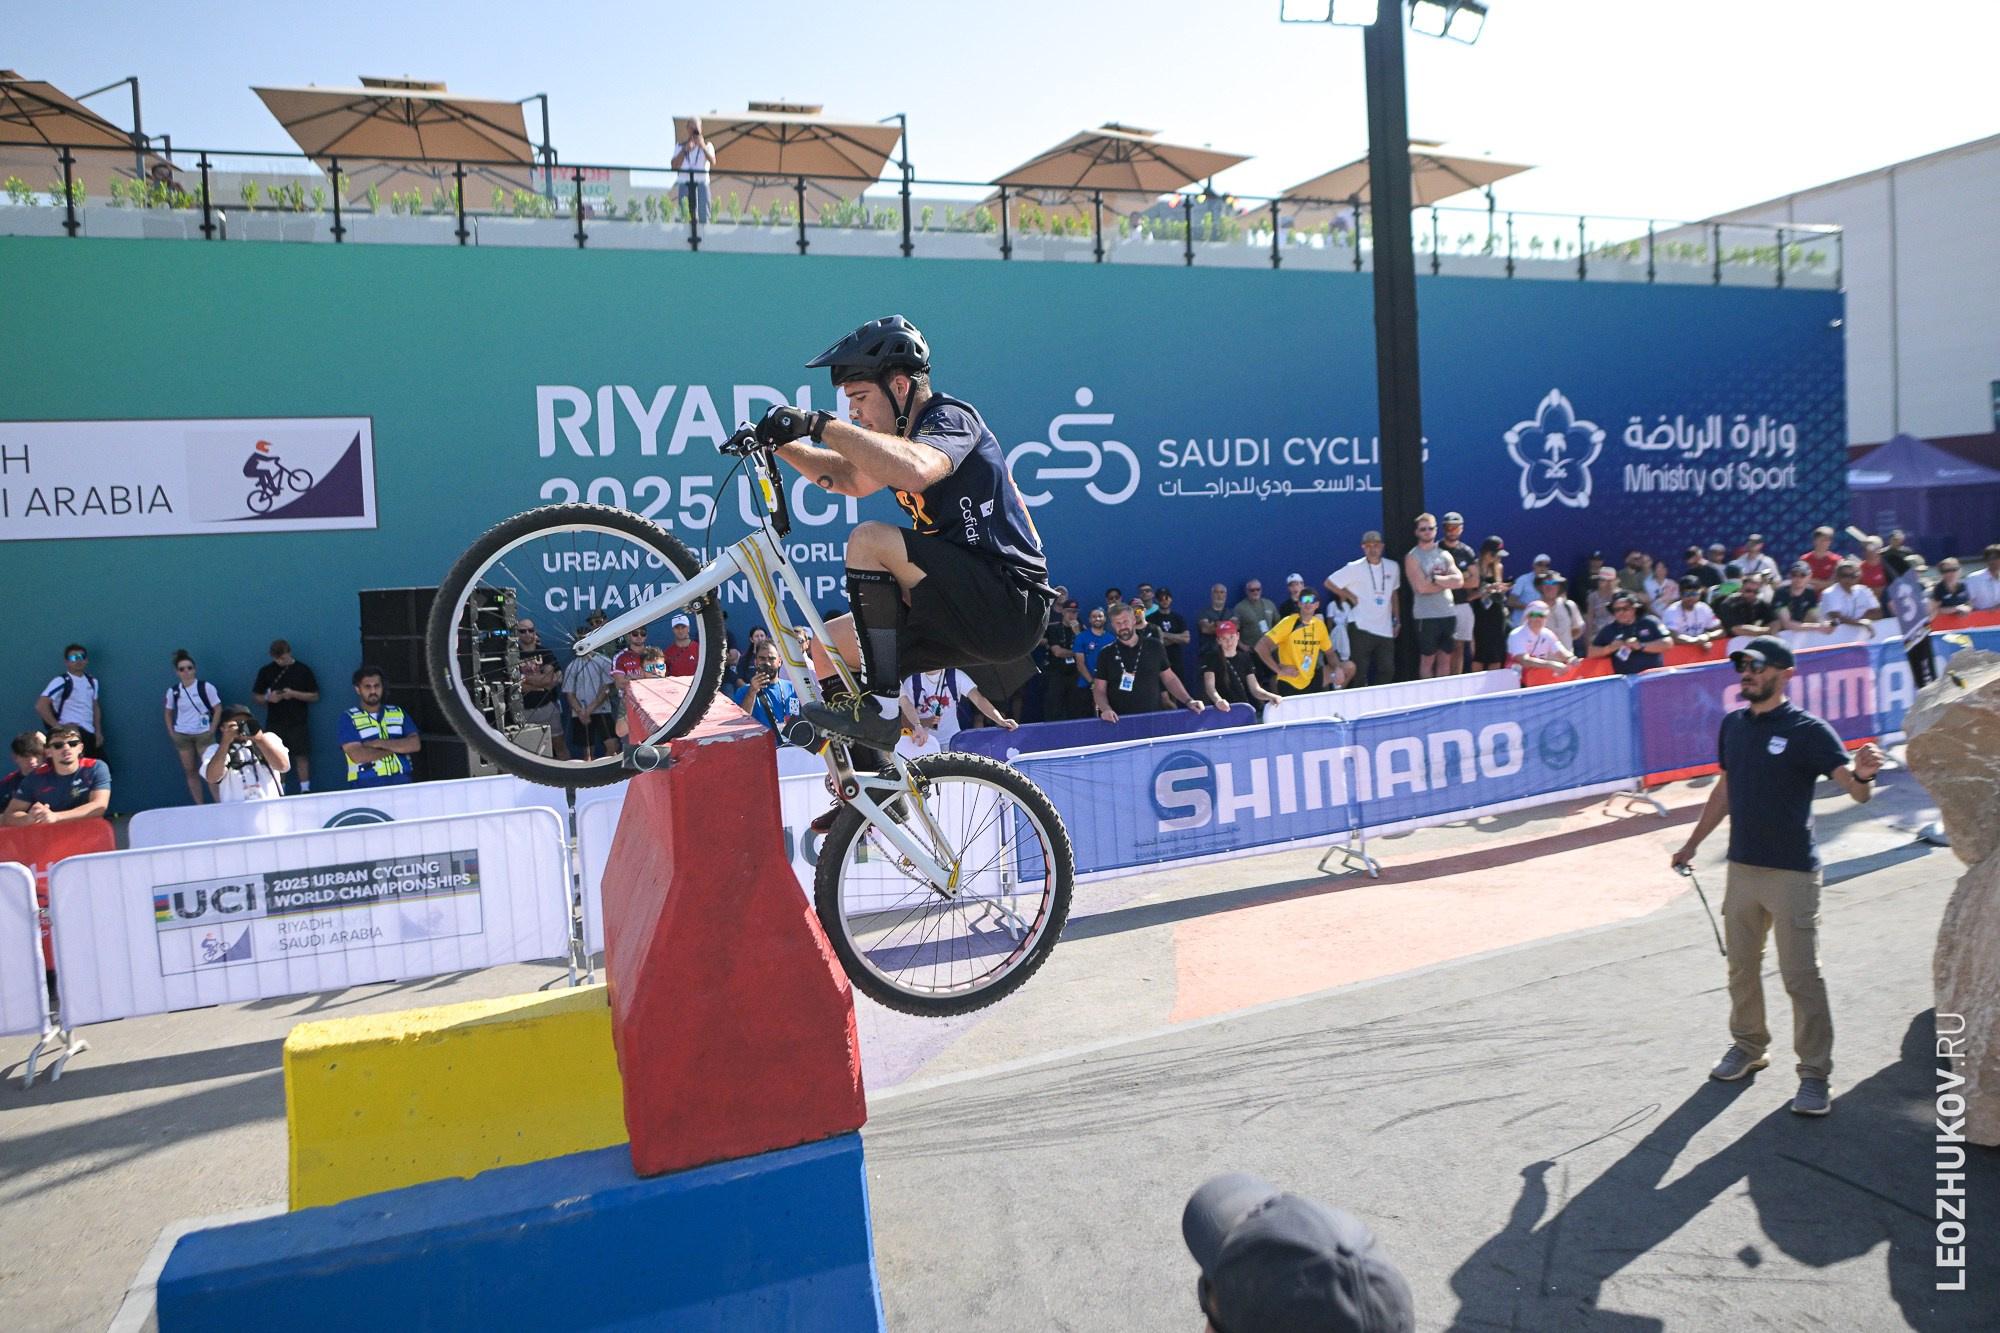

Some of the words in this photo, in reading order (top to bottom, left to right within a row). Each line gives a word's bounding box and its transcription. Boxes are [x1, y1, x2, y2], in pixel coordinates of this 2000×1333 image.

[1158, 437, 1270, 468] SAUDI
[1282, 436, 1429, 466] CYCLI
[1624, 414, 1723, 459] الرياضة
[1730, 414, 1797, 457] وزارة
[1624, 462, 1707, 496] Ministry
[1710, 462, 1735, 491] of
[1737, 461, 1797, 495] Sport
[24, 484, 174, 518] ARABIA
[542, 549, 640, 574] URBAN
[1155, 721, 1525, 833] SHIMANO
[272, 876, 310, 893] 2025
[314, 868, 369, 887] URBAN
[371, 860, 441, 881] CYCLING
[273, 888, 335, 908] WORLD
[338, 872, 472, 901] CHAMPIONSHIPS
[173, 882, 258, 920] UCI
[278, 917, 333, 935] RIYADH
[279, 934, 325, 951] SAUDI
[329, 926, 384, 945] ARABIA
